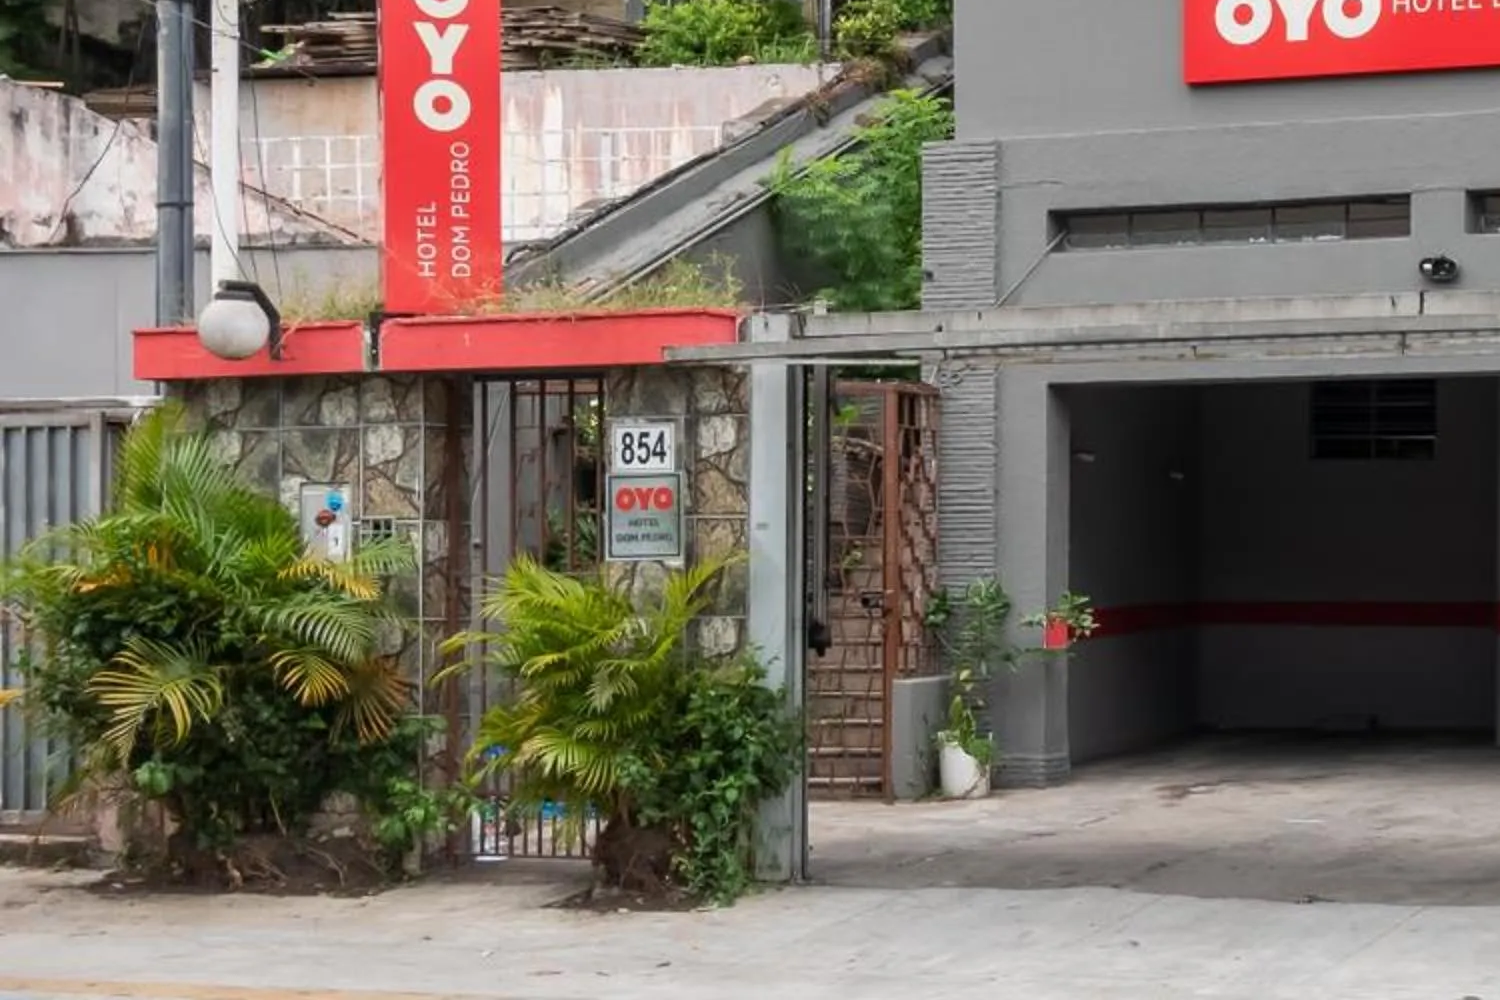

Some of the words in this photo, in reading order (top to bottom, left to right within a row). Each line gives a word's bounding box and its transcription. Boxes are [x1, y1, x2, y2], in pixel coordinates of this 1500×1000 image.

[450, 141, 471, 218] PEDRO
[416, 201, 437, 278] HOTEL
[451, 225, 471, 278] DOM
[621, 430, 667, 465] 854
[615, 486, 673, 511] OYO
